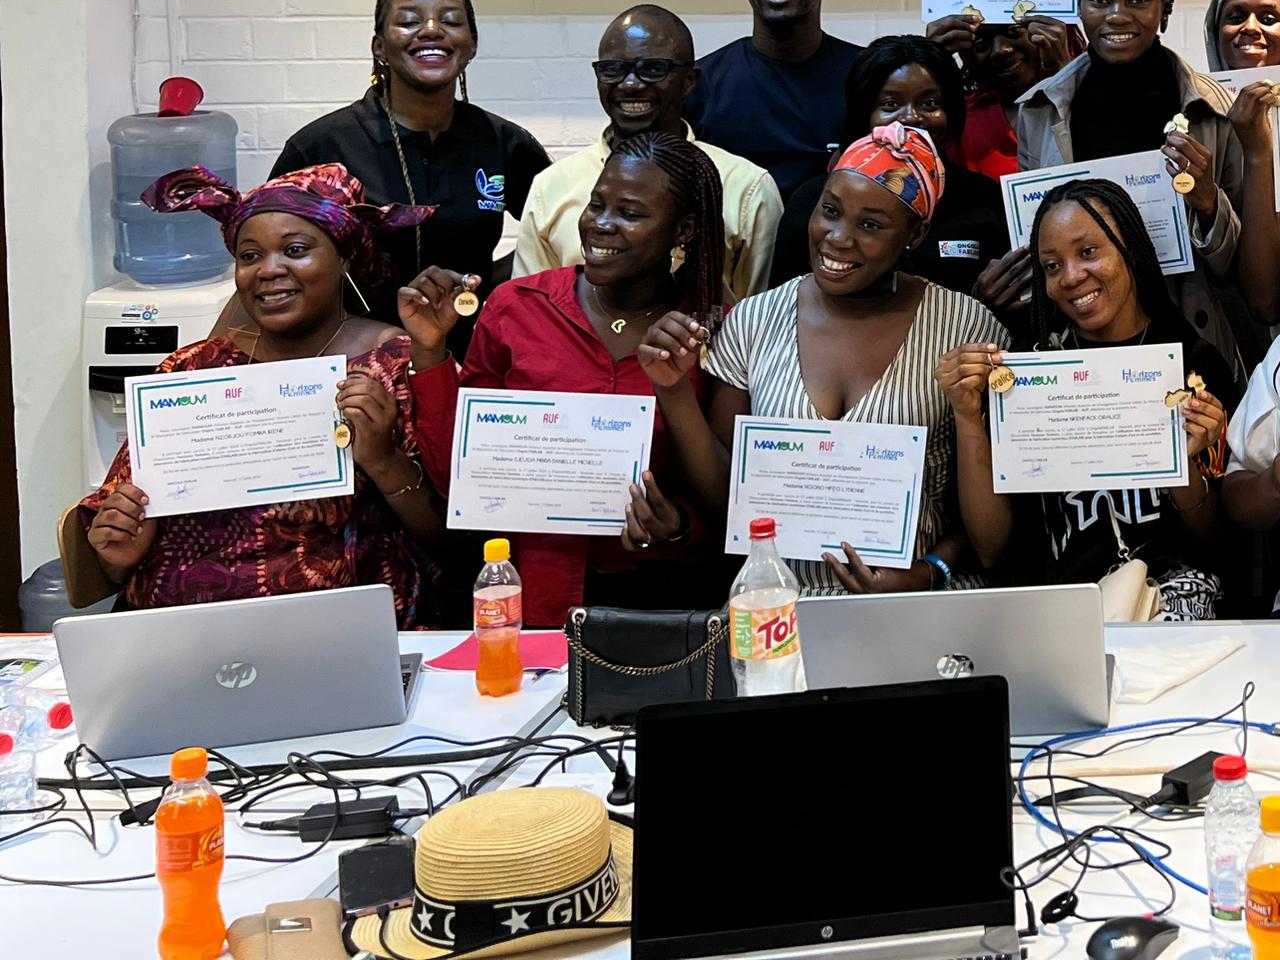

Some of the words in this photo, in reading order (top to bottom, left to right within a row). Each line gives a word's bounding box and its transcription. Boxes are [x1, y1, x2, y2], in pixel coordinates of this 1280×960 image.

[1227, 86, 1237, 94] UF
[990, 371, 1015, 390] oralice
[1073, 371, 1089, 381] AUF
[225, 387, 243, 399] AUF
[1084, 392, 1120, 401] participation
[196, 412, 226, 422] Certificat
[236, 407, 277, 417] participation
[543, 413, 559, 423] AUF
[514, 434, 541, 442] Certificat
[550, 436, 586, 444] participation
[819, 441, 835, 451] AUF
[792, 461, 817, 470] Certificat
[826, 464, 861, 472] participation
[935, 654, 974, 678] hp
[215, 661, 257, 689] hp
